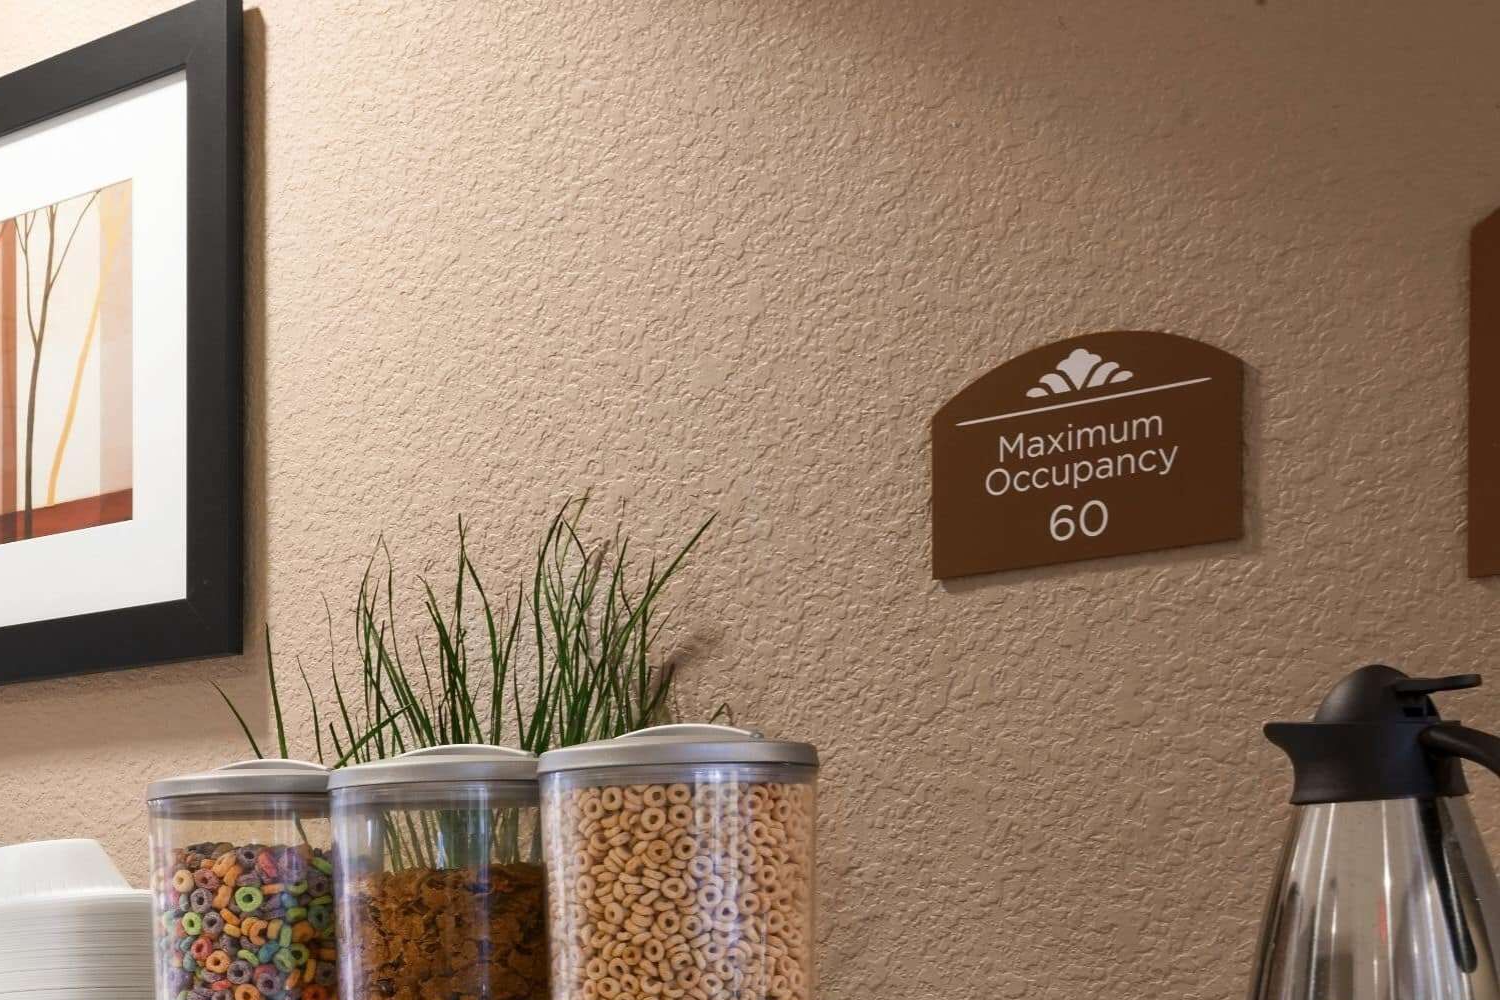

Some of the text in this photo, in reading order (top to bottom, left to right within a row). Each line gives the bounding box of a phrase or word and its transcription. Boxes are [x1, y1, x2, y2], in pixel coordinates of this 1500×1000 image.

[999, 415, 1163, 463] Maximum
[985, 445, 1179, 496] Occupancy
[1050, 500, 1109, 541] 60
